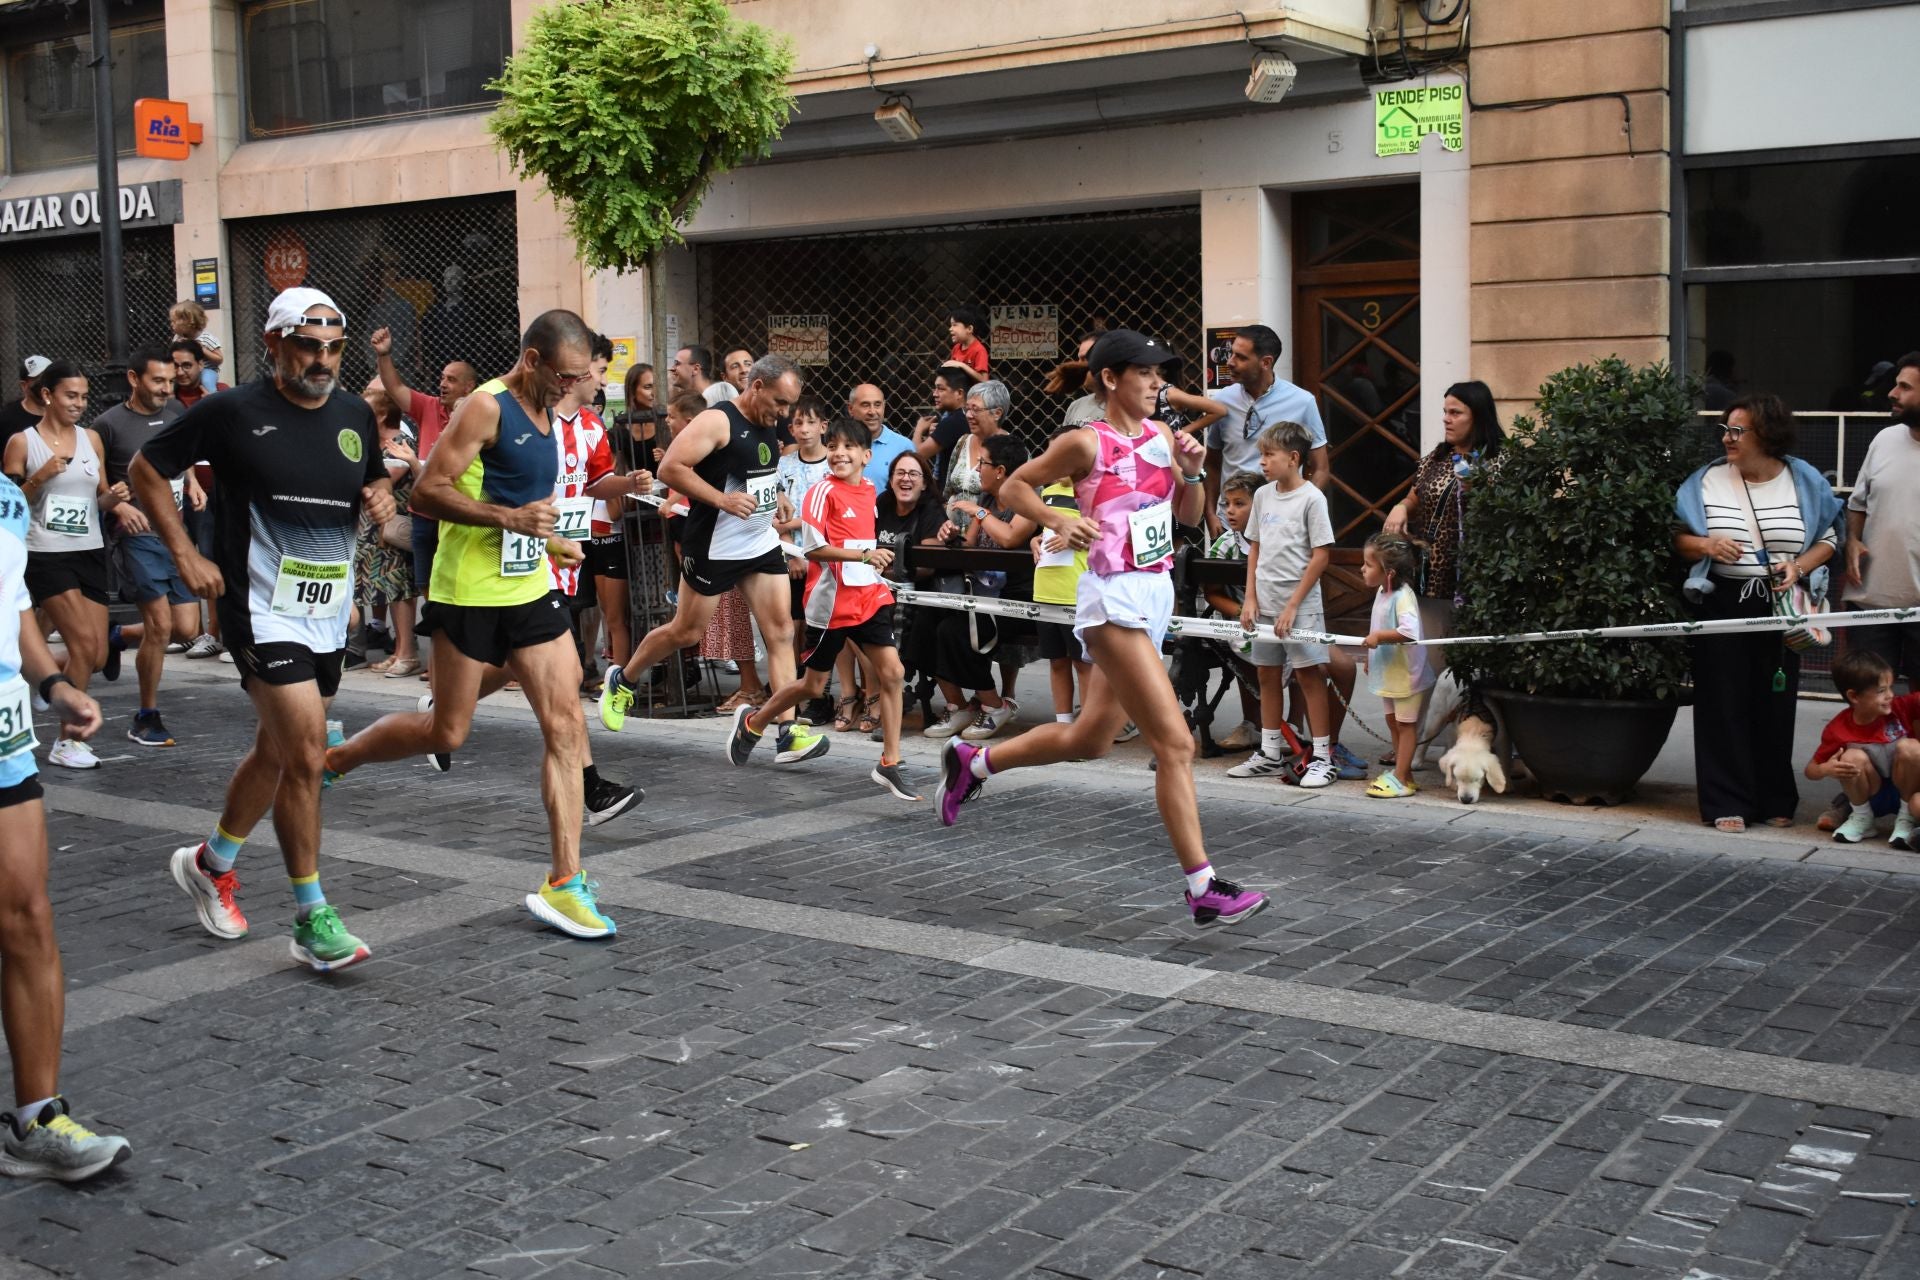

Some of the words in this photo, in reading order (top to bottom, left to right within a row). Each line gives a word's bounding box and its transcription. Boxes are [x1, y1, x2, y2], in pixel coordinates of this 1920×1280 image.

[1378, 89, 1425, 106] VENDE
[1429, 85, 1462, 101] PISO
[149, 115, 180, 137] Ria
[1418, 113, 1461, 123] INMOBILIARIA
[1384, 125, 1413, 139] DE
[0, 196, 64, 233] AZAR
[70, 185, 155, 226] OUDA
[992, 306, 1057, 320] VENDE
[1362, 301, 1381, 330] 3
[769, 316, 828, 329] INFORMA
[754, 485, 776, 505] 186
[52, 507, 87, 526] 222
[601, 535, 622, 545] NIKE
[1145, 521, 1167, 549] 94
[511, 537, 545, 560] 185
[282, 567, 306, 578] CIUDAD
[296, 581, 333, 605] 190
[1746, 618, 1782, 626] Gobierno
[1852, 612, 1889, 620] Gobierno
[1213, 629, 1240, 637] Gobierno
